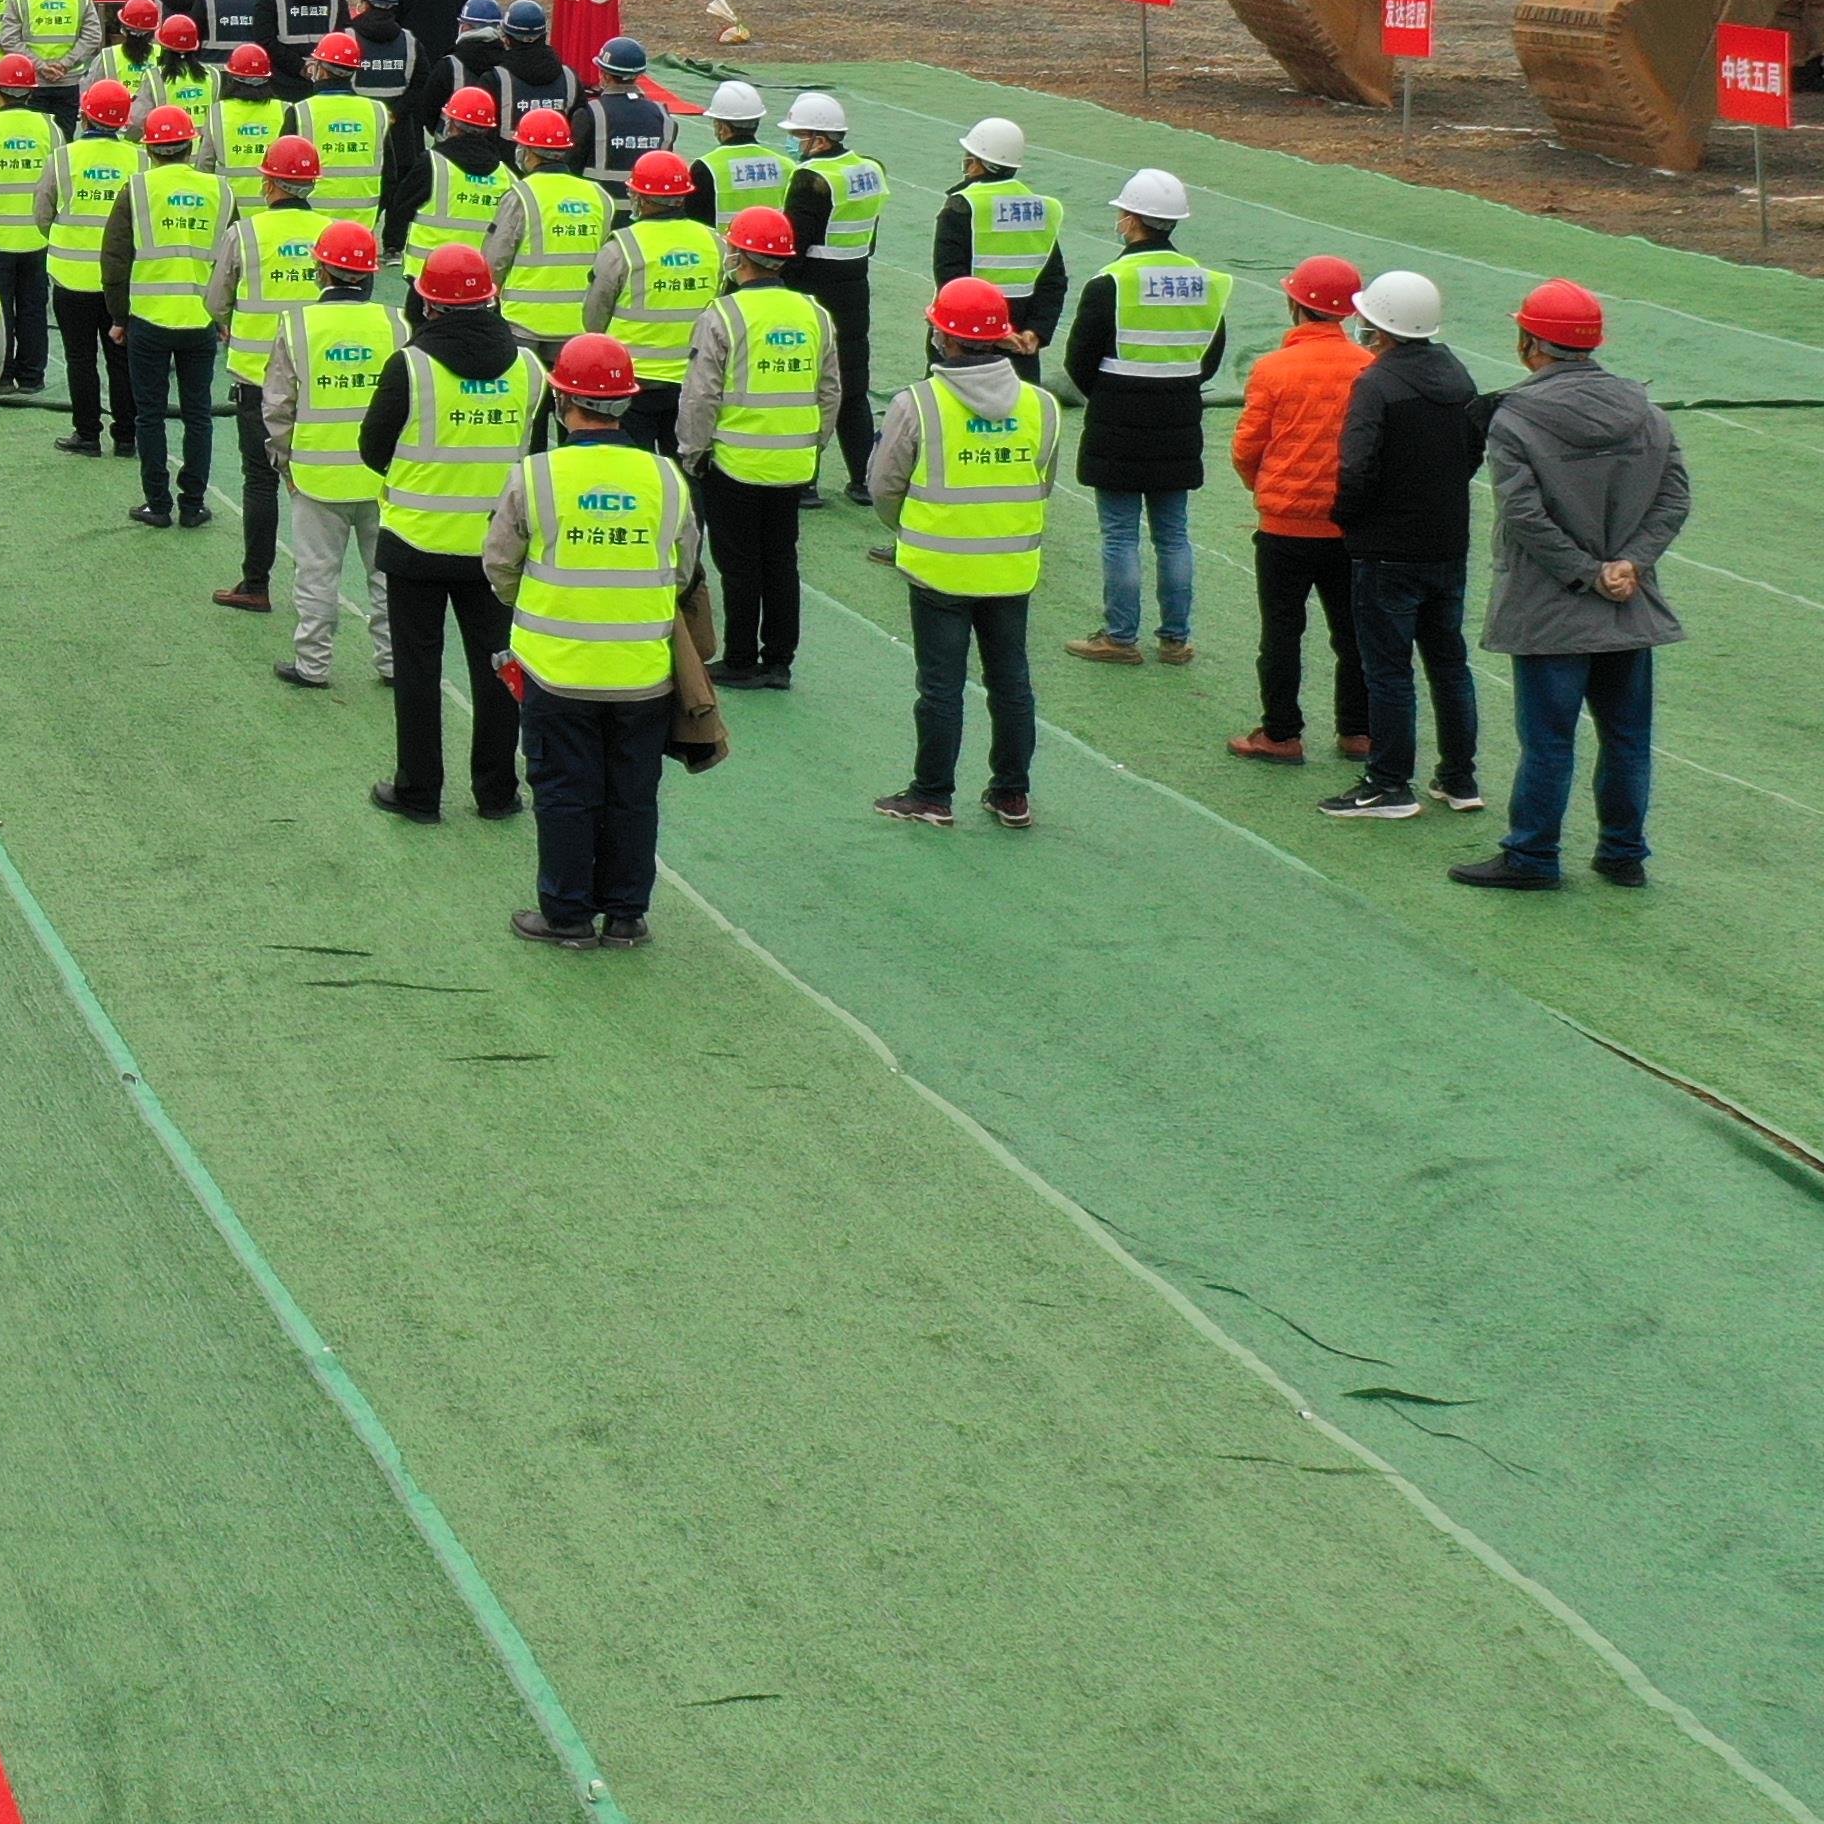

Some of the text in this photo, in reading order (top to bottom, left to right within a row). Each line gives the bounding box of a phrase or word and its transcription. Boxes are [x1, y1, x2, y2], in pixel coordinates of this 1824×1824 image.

[35, 16, 72, 26] 中冶建工
[1384, 0, 1427, 29] 发达控股
[1721, 55, 1781, 97] 中铁五局
[237, 125, 269, 136] MCC
[328, 121, 362, 133] MCC
[4, 139, 37, 150] MCC
[232, 144, 266, 154] 中冶建
[322, 141, 369, 153] 中冶建工
[83, 168, 121, 181] MCC
[734, 161, 779, 183] 上海高科
[849, 172, 881, 195] 上海高科
[77, 189, 117, 200] 中冶建
[167, 195, 205, 207] MCC
[456, 192, 502, 206] 中冶建工
[557, 202, 592, 214] MCC
[997, 201, 1045, 223] 上海高科
[161, 218, 209, 230] 中冶建工
[552, 224, 598, 236] 中冶建工
[660, 253, 700, 267] MCC
[270, 269, 316, 282] 中冶建
[653, 277, 710, 293] 中冶建工
[1144, 275, 1205, 298] 上海高科
[765, 331, 807, 345] MCC
[325, 348, 373, 362] MCC
[757, 358, 814, 374] 中冶建工
[317, 374, 381, 389] 中冶建工
[460, 378, 511, 395] MCC
[449, 408, 520, 426] 中冶建工
[957, 446, 1032, 466] 中冶建工
[578, 492, 637, 511] MCC
[566, 527, 650, 545] 中冶建工
